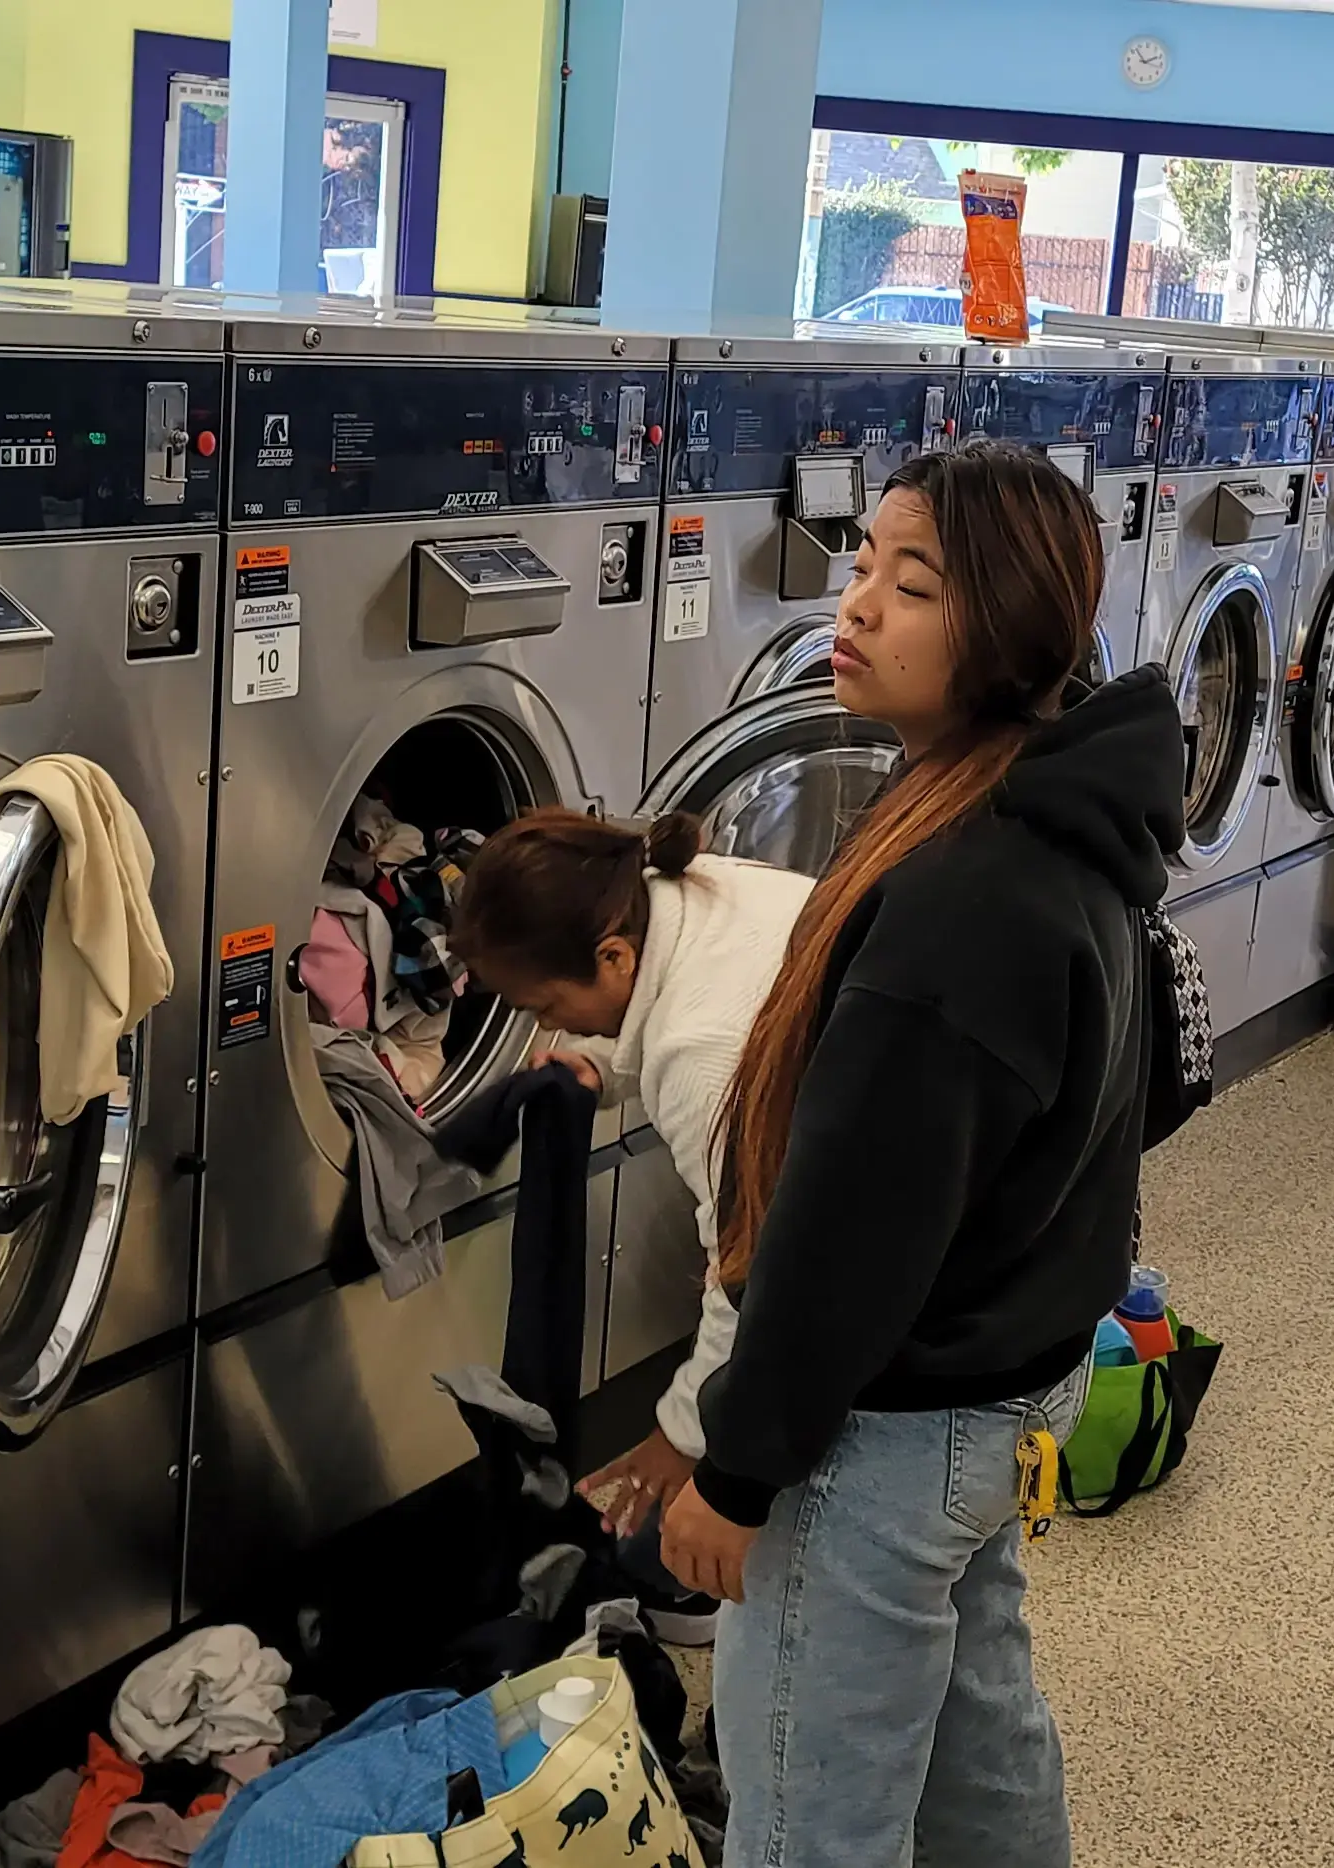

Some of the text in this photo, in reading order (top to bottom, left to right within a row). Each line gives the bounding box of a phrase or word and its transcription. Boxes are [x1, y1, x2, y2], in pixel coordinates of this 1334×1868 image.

[249, 368, 255, 382] 6
[258, 449, 293, 459] DEXTER
[444, 492, 498, 507] DEXTER
[681, 598, 695, 619] 11
[257, 649, 279, 675] 10
